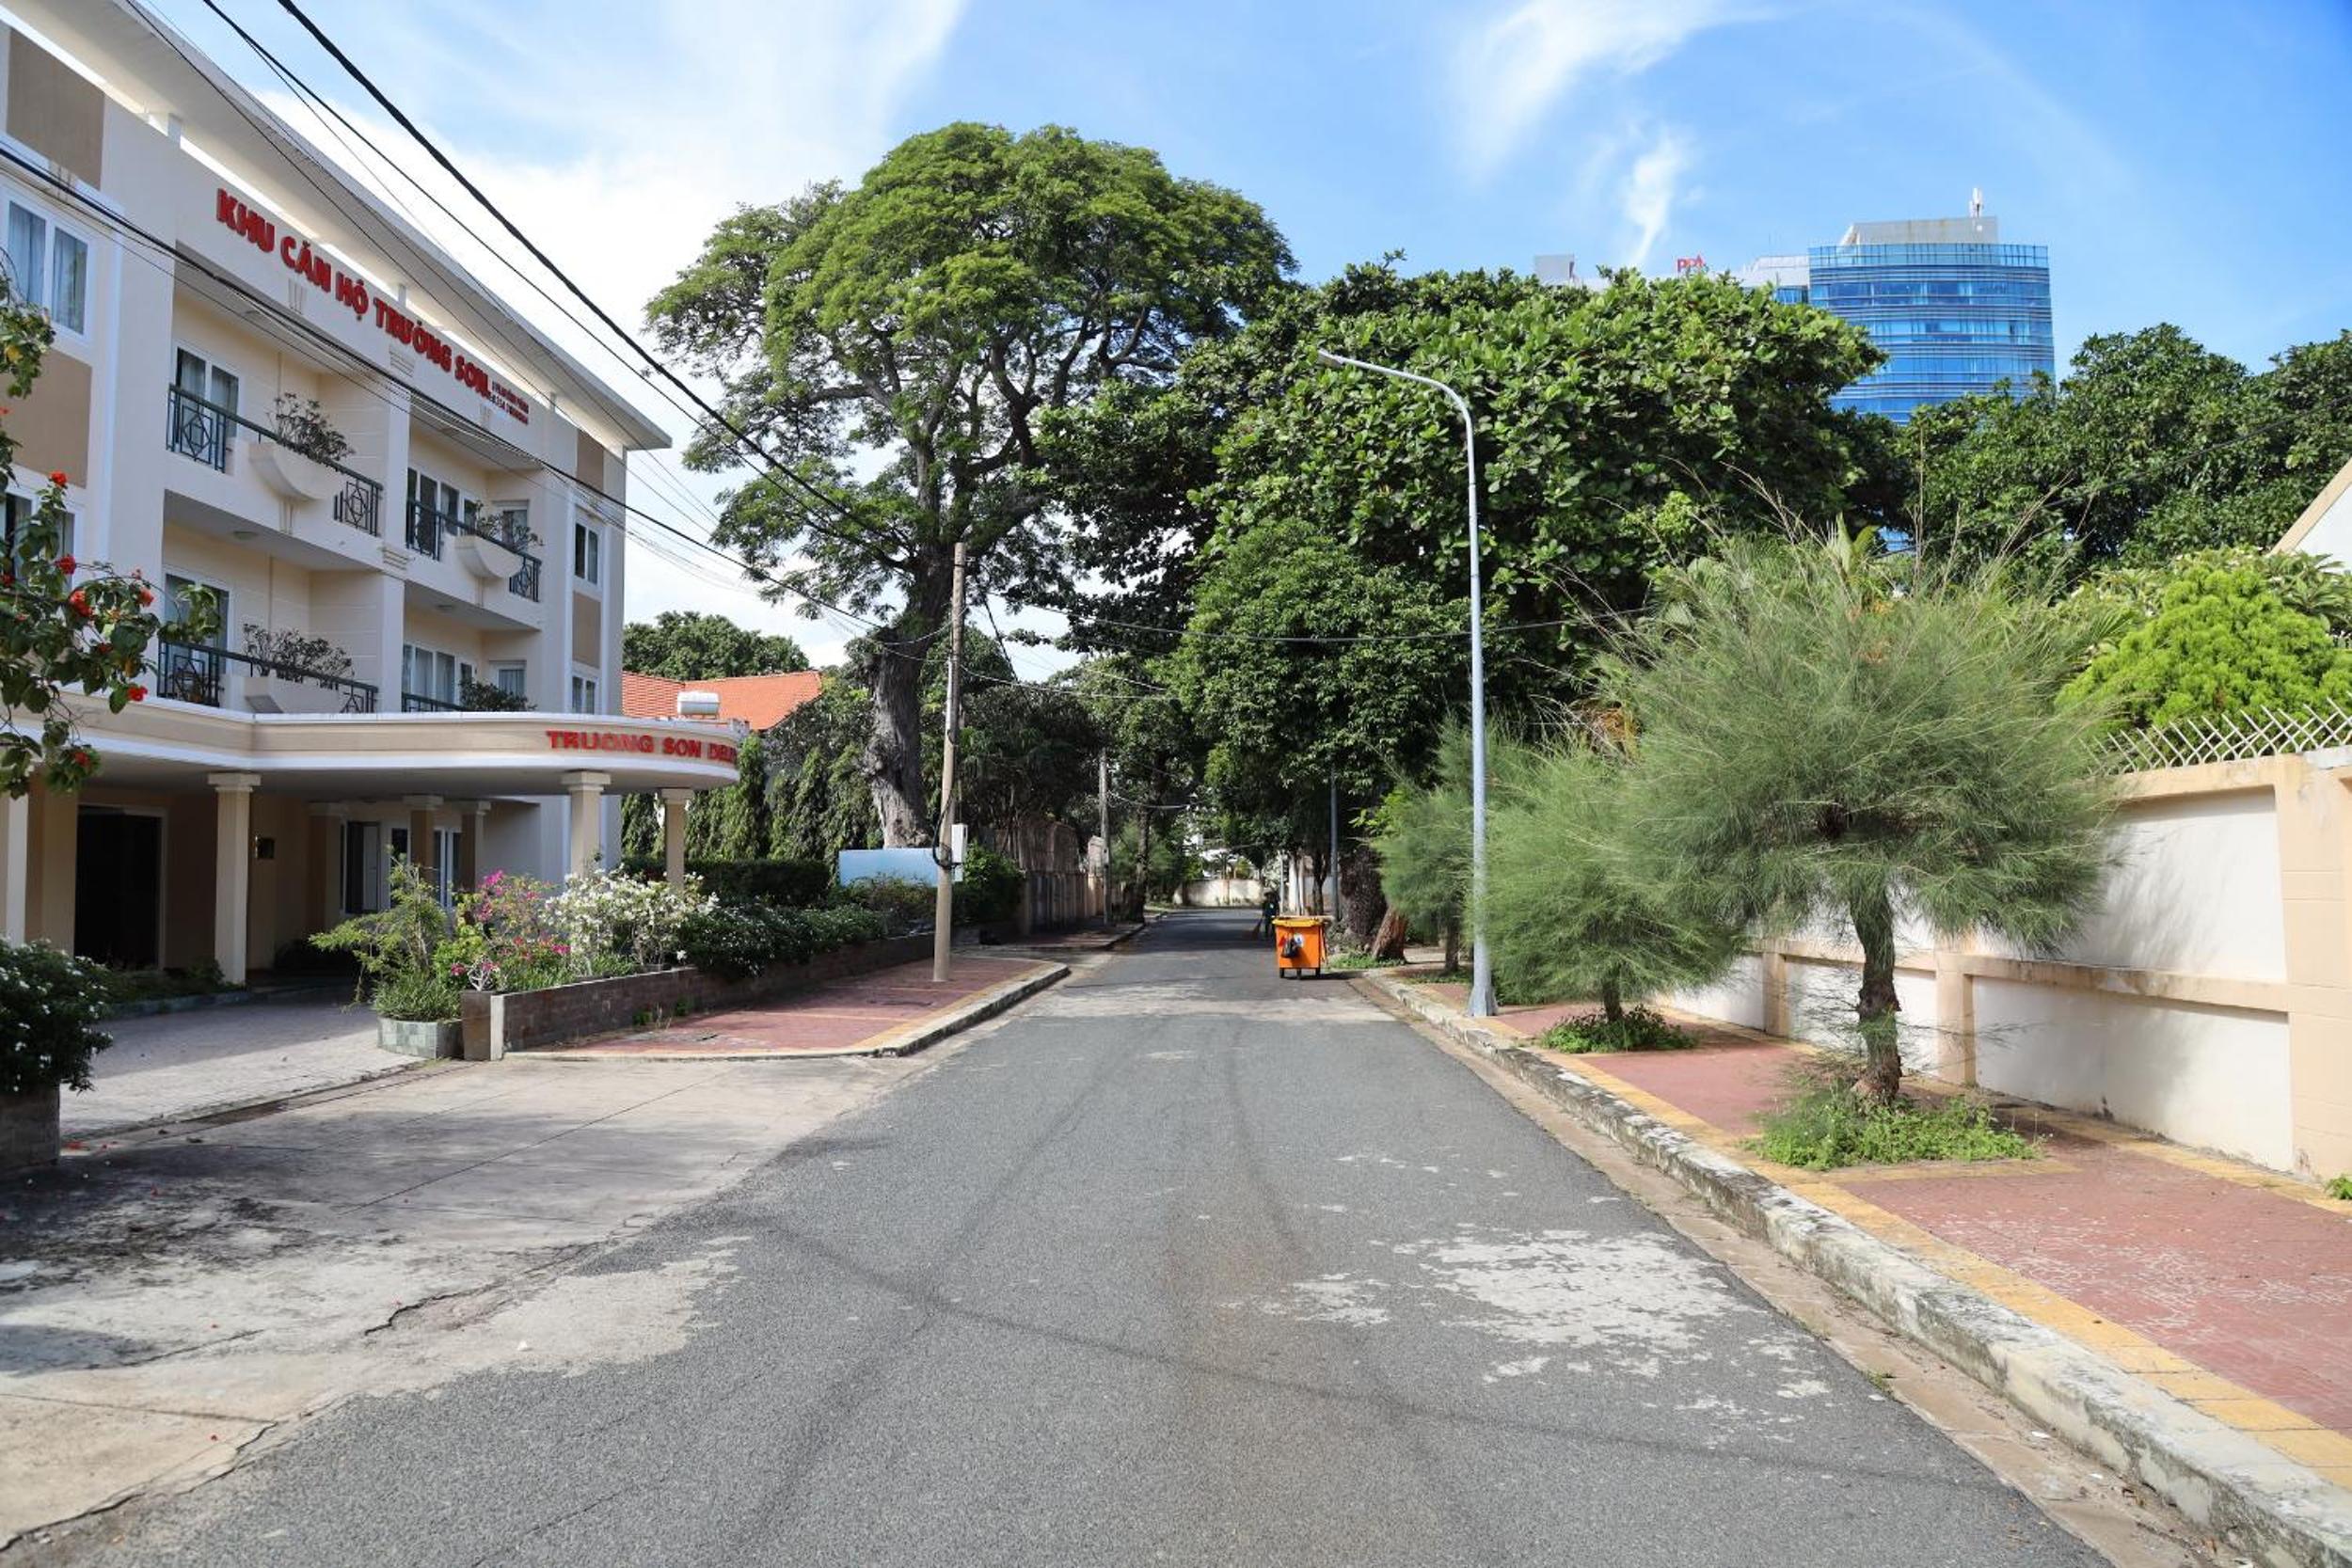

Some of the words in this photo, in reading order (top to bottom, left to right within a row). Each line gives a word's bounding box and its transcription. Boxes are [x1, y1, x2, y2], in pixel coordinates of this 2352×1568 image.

[216, 188, 275, 253] KHU
[280, 236, 331, 293] CĂN
[336, 271, 369, 322] HỘ
